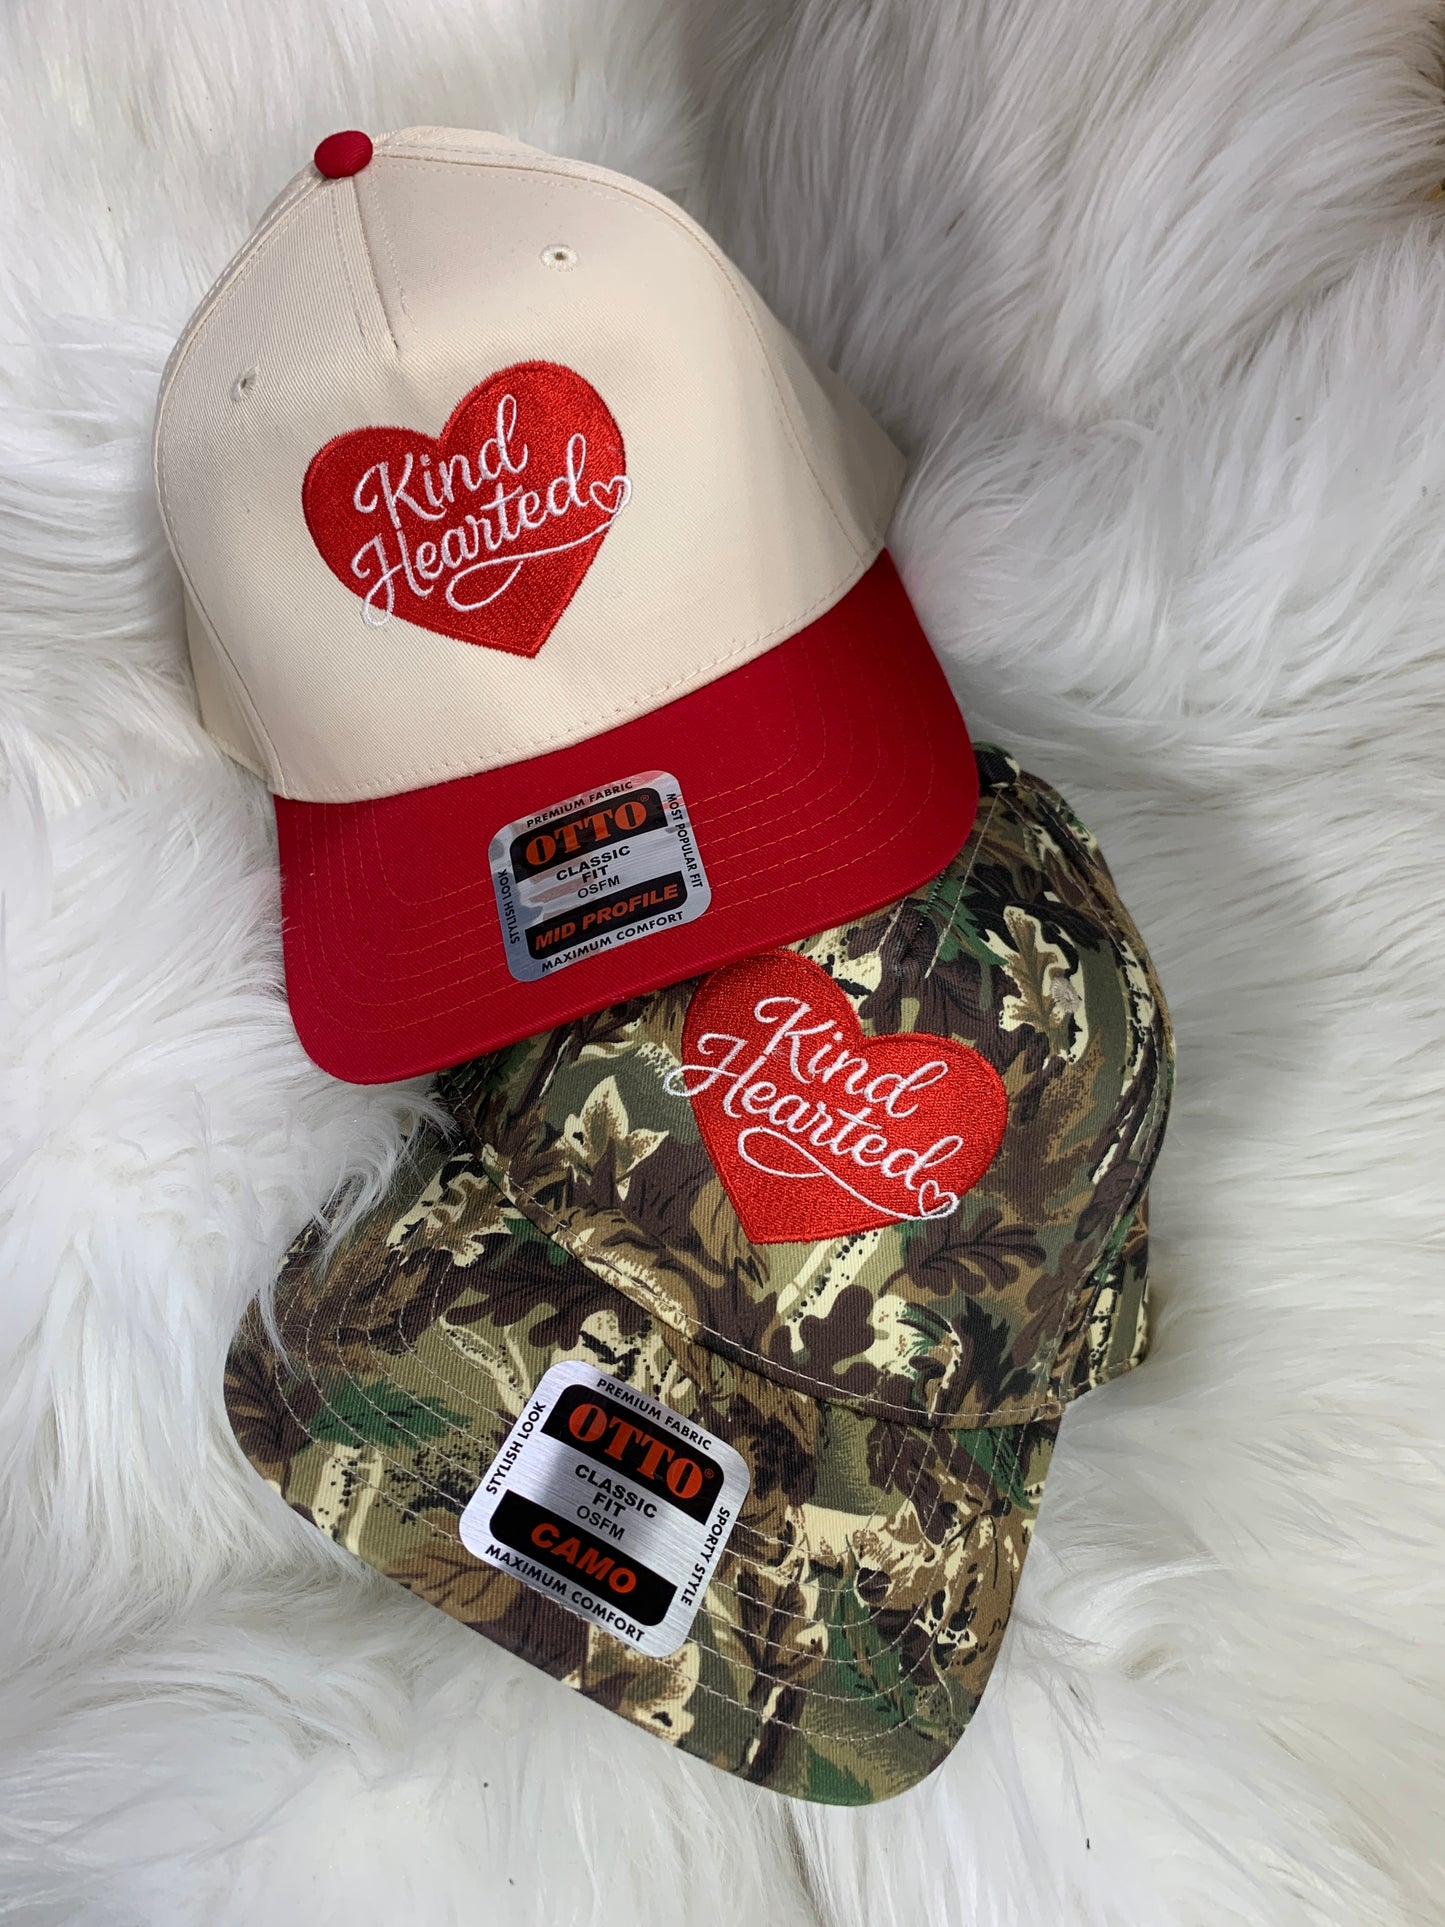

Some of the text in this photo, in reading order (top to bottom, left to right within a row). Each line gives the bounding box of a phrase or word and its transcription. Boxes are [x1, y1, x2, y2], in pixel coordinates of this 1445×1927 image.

[353, 394, 527, 529] Kind
[352, 433, 590, 628] Hearted
[526, 781, 634, 828] PREMIUM FABRIC
[666, 793, 703, 888] MOST POPULAR FIT
[556, 845, 631, 881] CLASSIC
[577, 875, 620, 899] OSFM
[582, 865, 609, 883] FIT
[498, 868, 520, 944] STYLISH LOOK
[535, 884, 679, 951] MID PROFILE
[542, 911, 684, 972] MAXIMUM COMFORT
[754, 996, 949, 1118] Kind
[663, 1032, 964, 1191] Hearted
[486, 1401, 547, 1495] STYLISH LOOK
[596, 1378, 712, 1451] PREMIUM FABRIC
[575, 1464, 658, 1519] CLASSIC
[576, 1504, 625, 1541] OSFM
[592, 1492, 626, 1518] FIT
[530, 1522, 637, 1594] CAMO
[681, 1506, 730, 1606] SPORTY STYLE
[485, 1543, 645, 1643] MAXIMUM COMFORT
